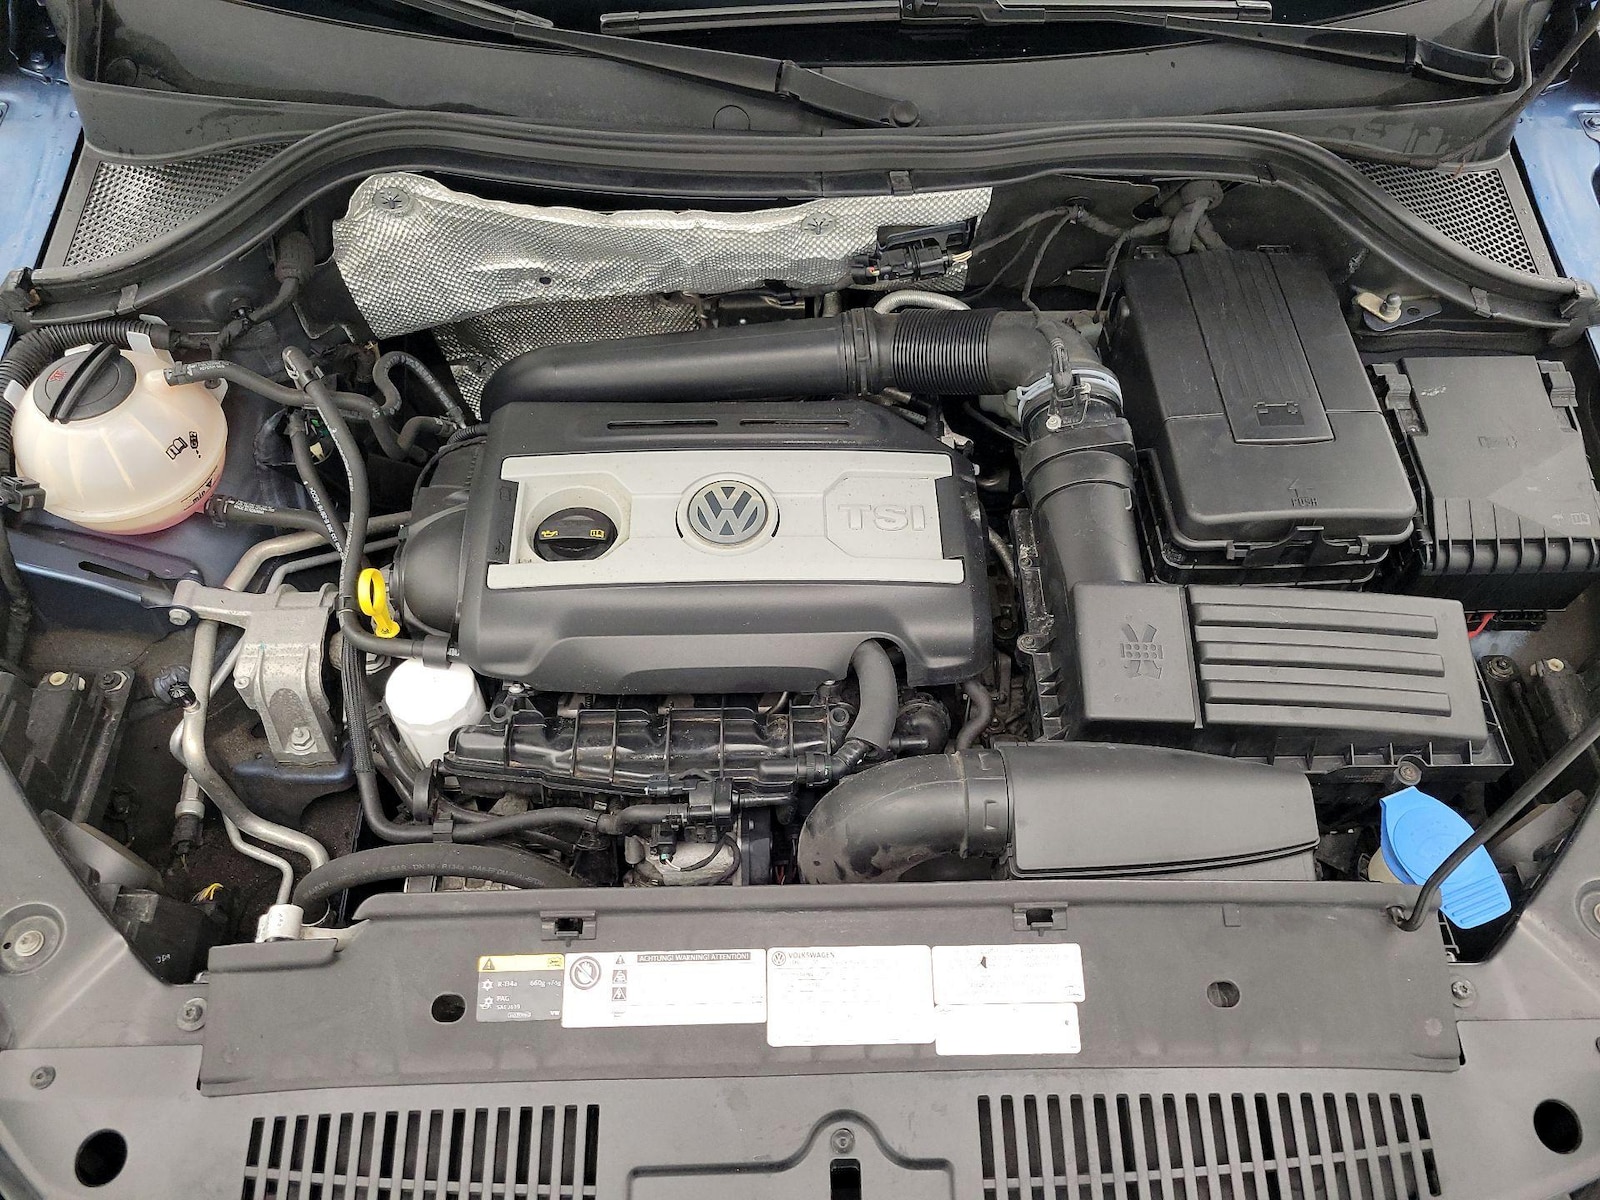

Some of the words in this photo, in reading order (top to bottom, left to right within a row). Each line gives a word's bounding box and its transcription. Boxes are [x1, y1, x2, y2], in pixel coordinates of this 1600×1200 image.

[837, 504, 925, 531] TSI
[675, 953, 710, 961] WARNING!
[711, 952, 749, 960] ATTENTION!
